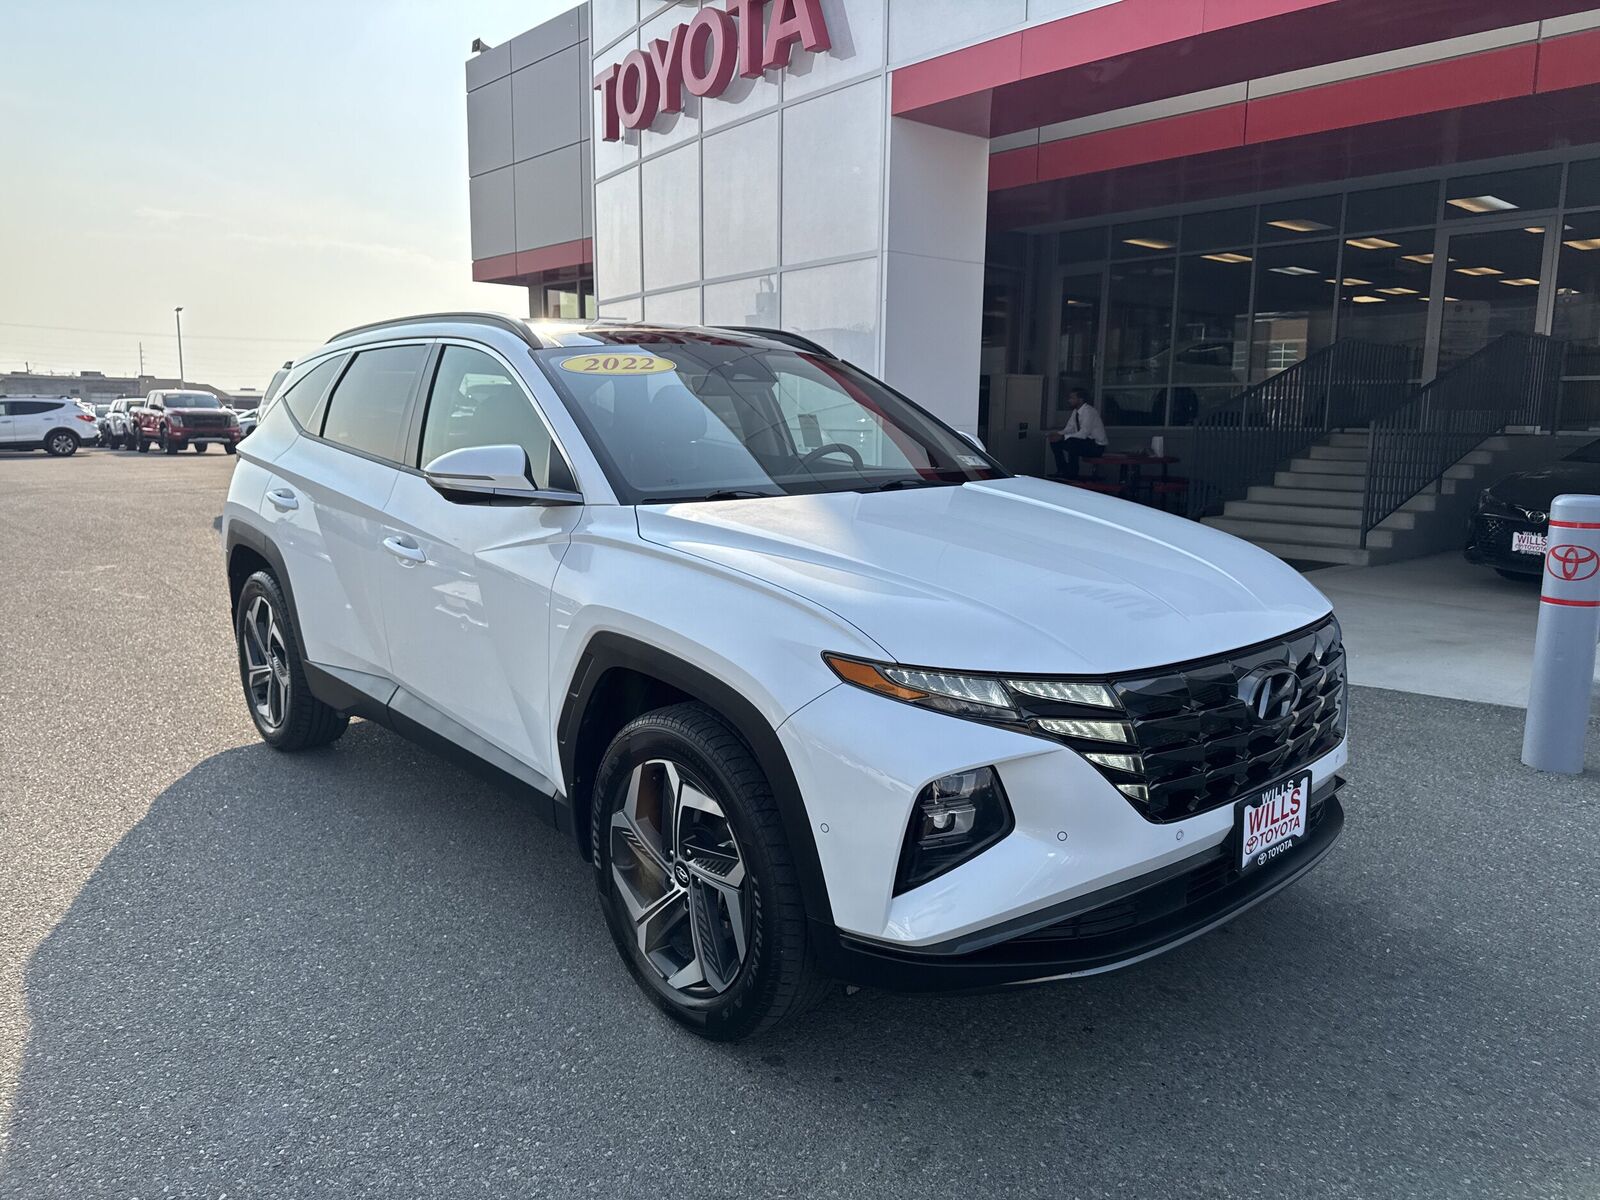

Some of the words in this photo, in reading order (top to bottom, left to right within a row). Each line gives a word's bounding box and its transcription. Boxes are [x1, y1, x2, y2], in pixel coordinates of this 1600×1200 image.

[594, 0, 831, 142] TOYOTA
[584, 357, 655, 371] 2022
[1517, 535, 1547, 546] WILLS
[1261, 780, 1294, 805] WILLS
[1249, 788, 1301, 835] WILLS
[1259, 816, 1301, 847] TOYOTA
[1268, 839, 1293, 859] TOYOTA
